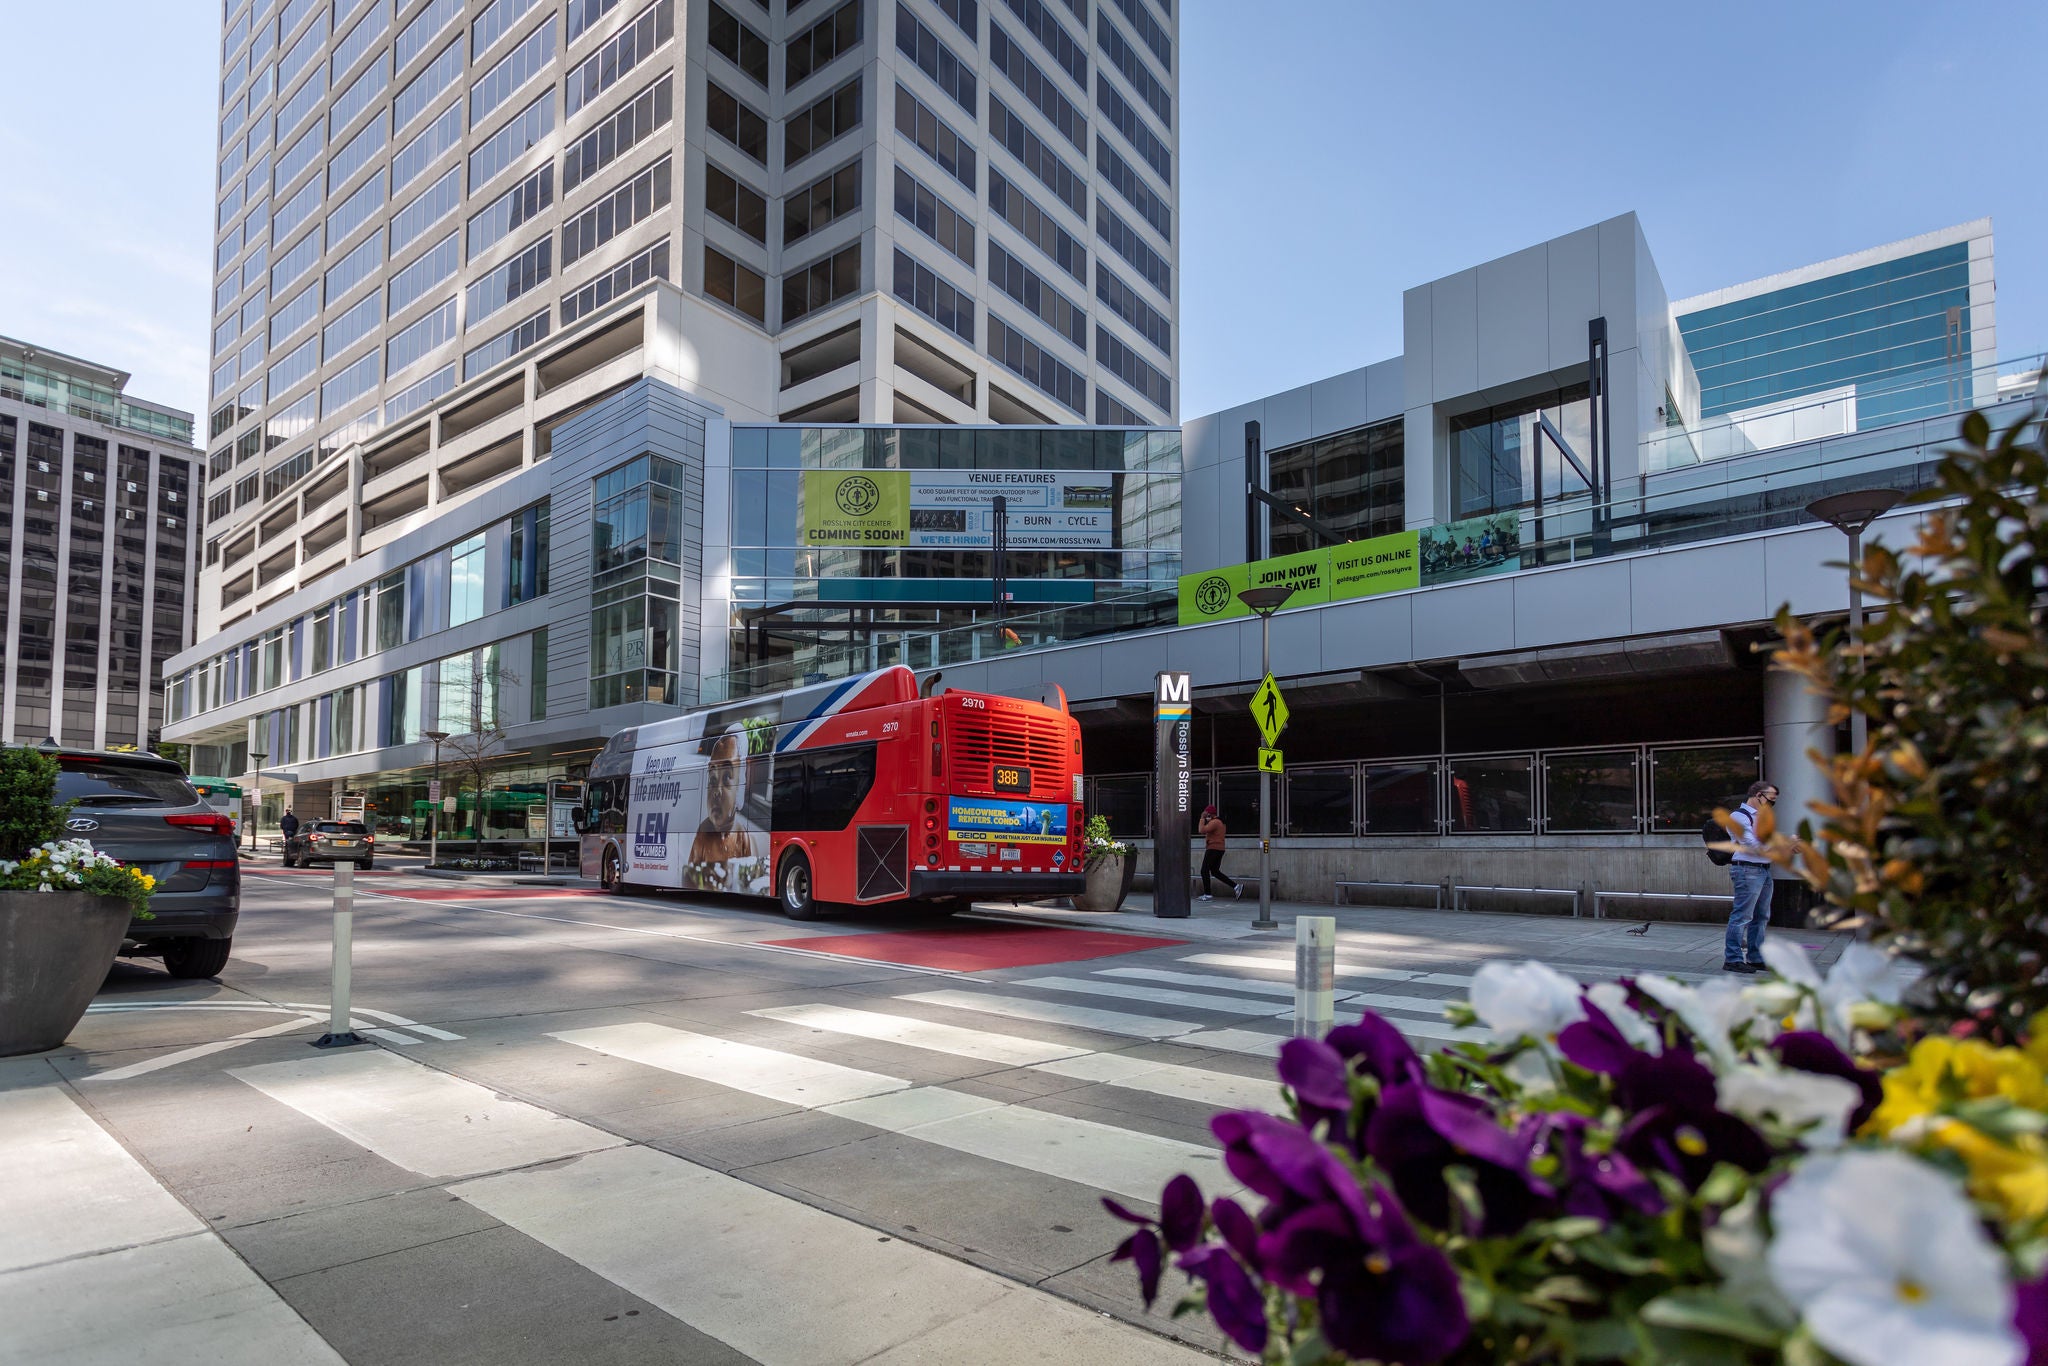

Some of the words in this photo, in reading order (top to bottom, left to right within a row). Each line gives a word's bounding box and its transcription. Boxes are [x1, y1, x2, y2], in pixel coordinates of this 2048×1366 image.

[969, 474, 1002, 483] VENUE
[1005, 474, 1056, 483] FEATURES
[843, 502, 873, 513] GYM
[1024, 516, 1052, 525] BURN
[1067, 516, 1098, 526] CYCLE
[809, 529, 860, 540] COMING
[864, 530, 904, 540] SOON!
[920, 535, 951, 544] WE'RE
[952, 535, 990, 544] HIRING!
[1336, 558, 1359, 570] VISIT
[1361, 556, 1373, 566] US
[1375, 549, 1412, 563] ONLINE
[1259, 569, 1286, 584] JOIN
[1289, 563, 1317, 579] NOW
[1336, 565, 1412, 584] goldsgym.com/rosslynva
[1202, 599, 1226, 611] GYM
[1161, 674, 1189, 701] M
[962, 697, 985, 709] 2970
[882, 721, 899, 732] 2970
[1176, 721, 1189, 767] Rosslyn
[997, 769, 1018, 785] 38B
[634, 777, 647, 802] life
[648, 781, 681, 807] moving.
[1178, 771, 1189, 812] Station
[952, 807, 1008, 817] HOMEOWNERS.
[958, 815, 993, 824] RENTERS.
[993, 817, 1022, 826] CONDO.
[635, 812, 669, 844] LEN
[640, 845, 666, 857] PLUMBER
